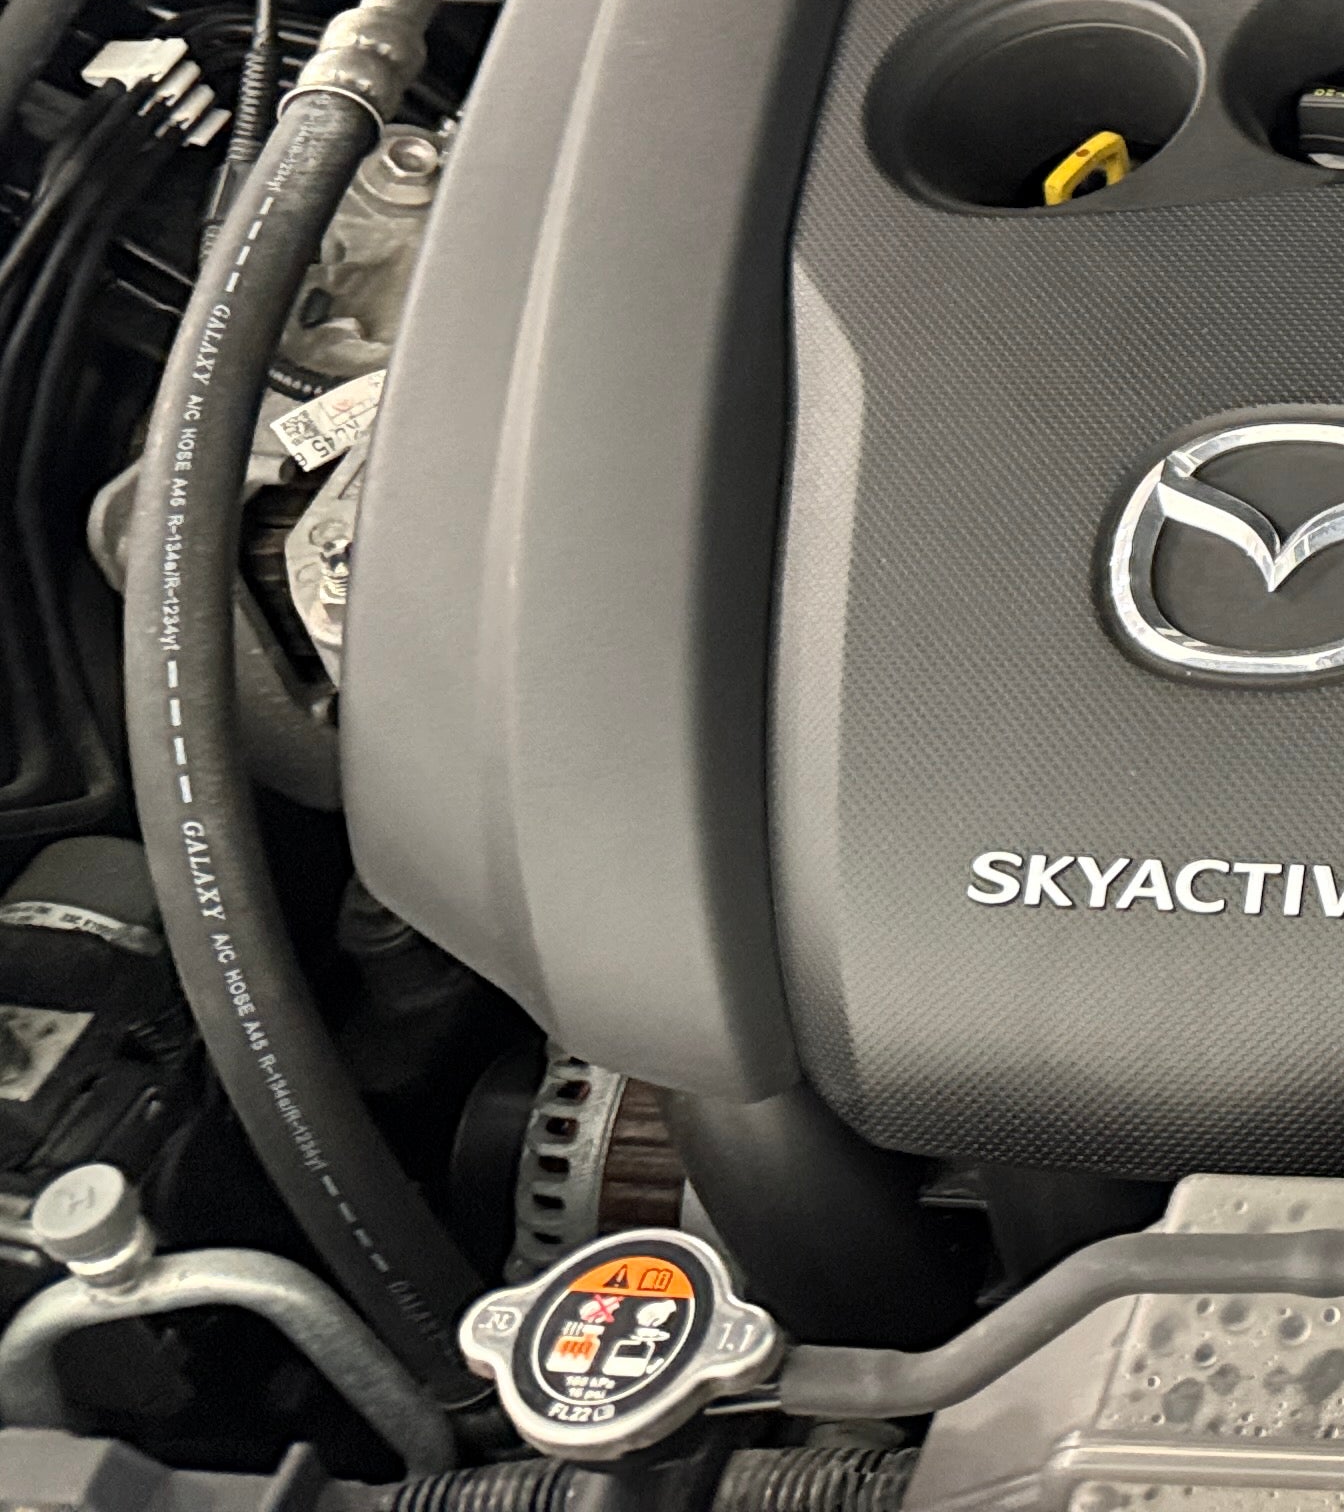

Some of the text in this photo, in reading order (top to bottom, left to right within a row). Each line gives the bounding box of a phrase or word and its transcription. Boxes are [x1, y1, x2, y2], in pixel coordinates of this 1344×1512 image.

[191, 304, 232, 386] GALAXY
[183, 394, 205, 421] A/C
[174, 428, 198, 472] HOSE
[181, 821, 227, 921] GALAXY
[209, 933, 237, 964] A/C
[223, 968, 256, 1017] HOSE
[548, 1403, 593, 1423] FL22
